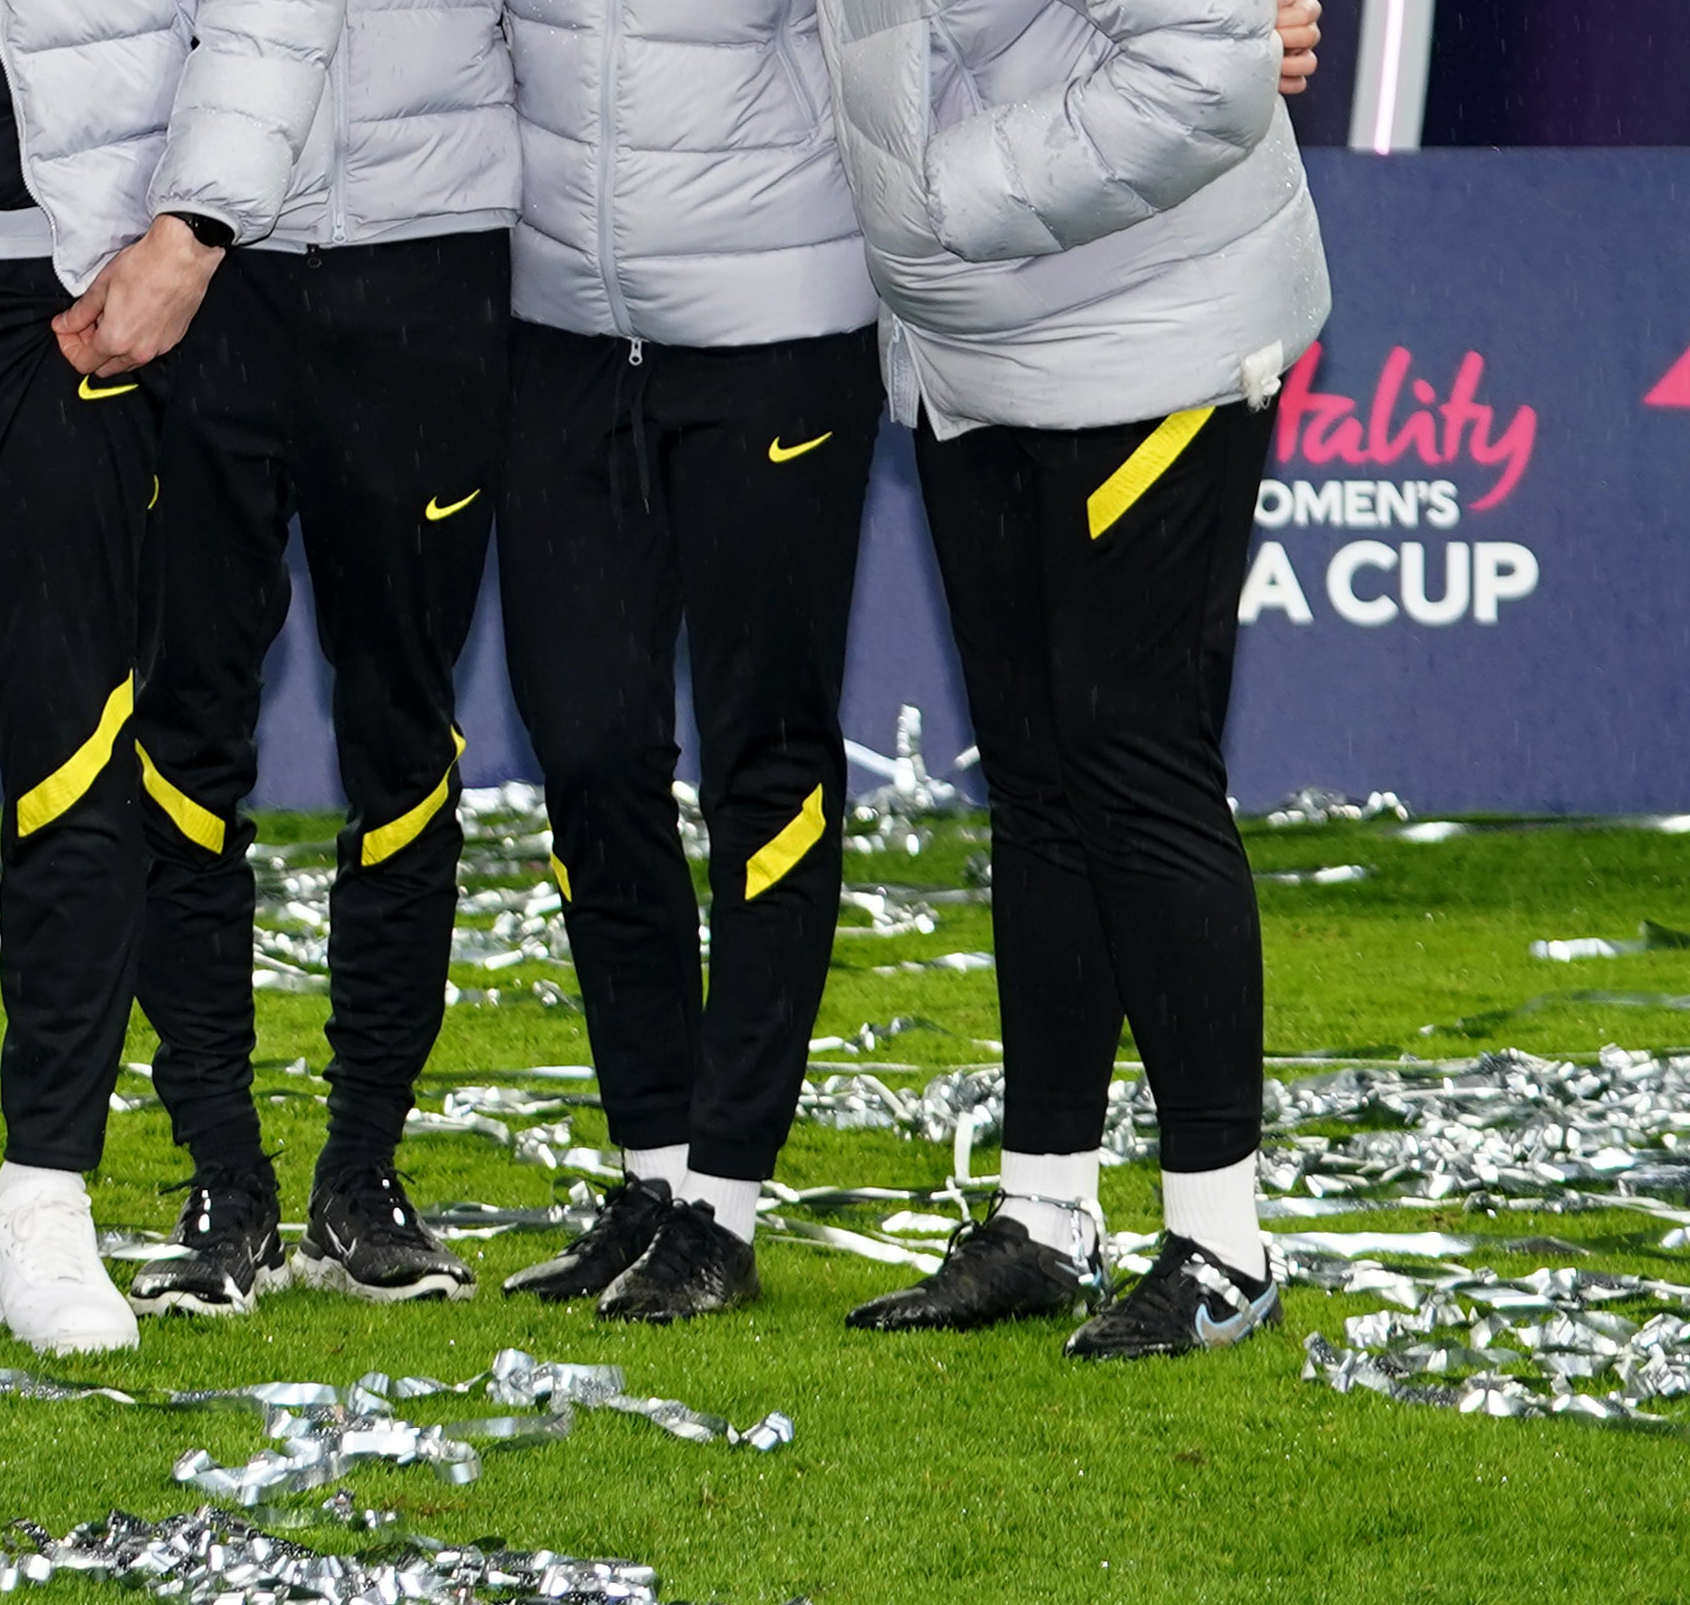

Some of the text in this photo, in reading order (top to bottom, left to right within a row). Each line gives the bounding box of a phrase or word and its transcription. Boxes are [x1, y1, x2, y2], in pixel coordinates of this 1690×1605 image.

[1274, 340, 1538, 511] tality
[1253, 479, 1461, 530] OMEN'S
[1236, 539, 1540, 625] A CUP
